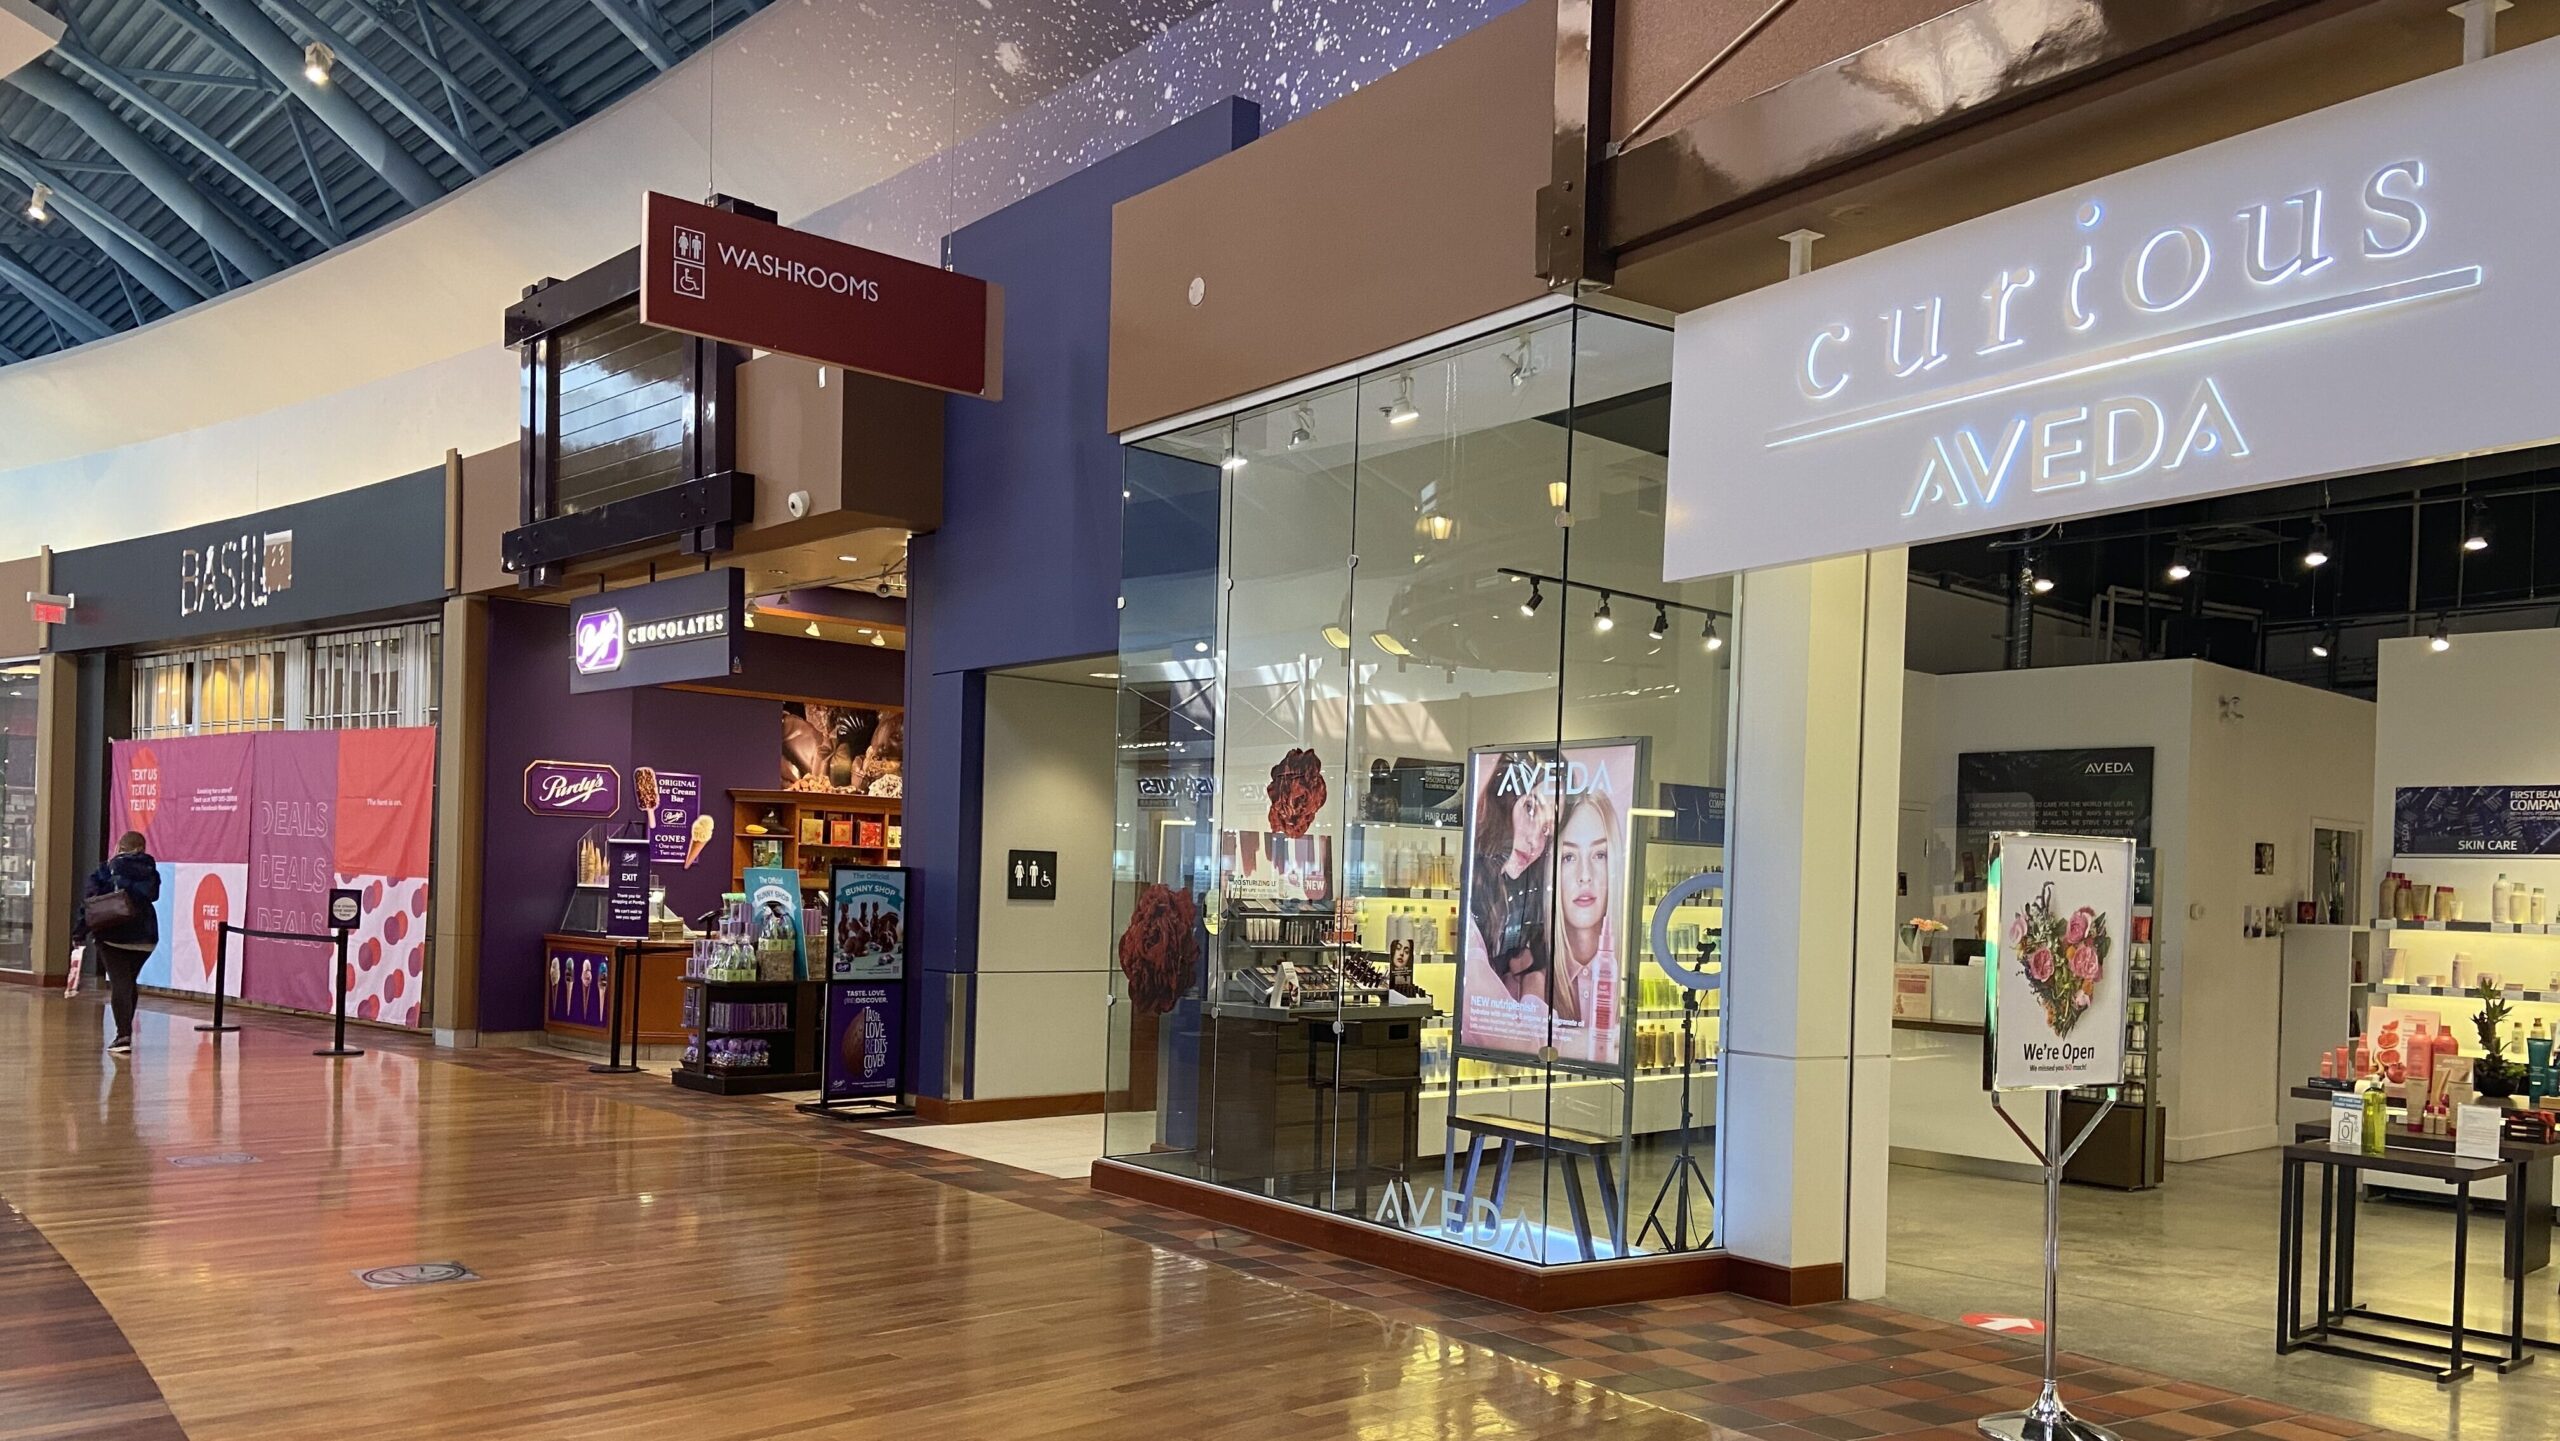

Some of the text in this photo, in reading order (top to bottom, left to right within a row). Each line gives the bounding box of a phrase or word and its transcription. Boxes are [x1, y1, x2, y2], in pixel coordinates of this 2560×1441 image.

[717, 242, 880, 302] WASHROOMS
[1799, 158, 2430, 401] curious
[1901, 376, 2251, 517] AVEDA
[627, 613, 724, 644] CHOCOLATES
[2084, 762, 2134, 774] AVEDA
[131, 769, 157, 780] TEXT US
[1497, 759, 1614, 797] AVEDA
[659, 779, 696, 788] ORIGINAL
[131, 784, 156, 796] TEXT US
[539, 774, 608, 807] Purdy's
[672, 788, 696, 796] Cream
[2510, 791, 2535, 799] FIRST
[130, 799, 156, 811] TEXT US
[671, 795, 685, 803] Bar
[260, 801, 329, 838] DEALS
[1425, 811, 1458, 823] HAIR CARE
[655, 834, 686, 843] CONES
[2458, 840, 2518, 850] SKIN CARE
[2027, 848, 2103, 874] AVEDA
[258, 854, 327, 893] DEALS
[621, 873, 638, 881] EXIT
[759, 876, 767, 884] The
[1306, 880, 1325, 891] NEW
[756, 890, 789, 902] BUNNY SHOP
[845, 884, 896, 896] BUNNY SHOP
[202, 905, 219, 917] FREE
[256, 907, 323, 949] DEALS
[1471, 995, 1490, 1007] NEW
[865, 1022, 886, 1038] LOVE
[2023, 1043, 2094, 1064] We're Open
[864, 1054, 885, 1069] COVER
[1374, 1179, 1539, 1260] AVEDA
